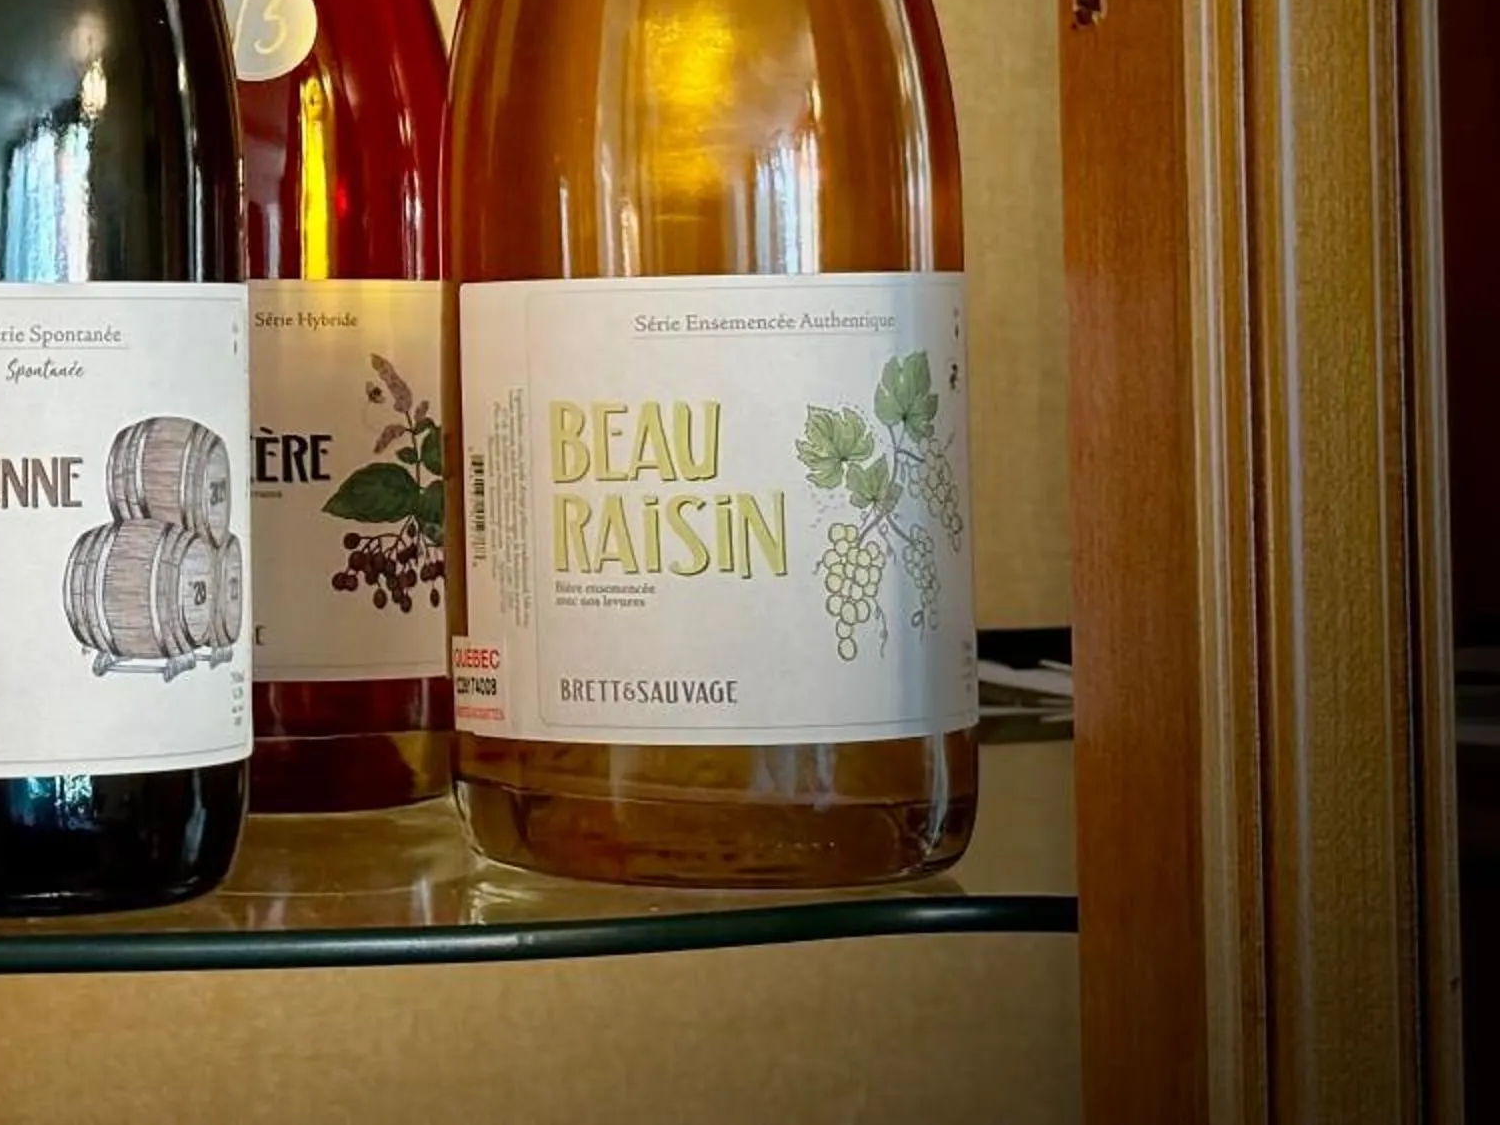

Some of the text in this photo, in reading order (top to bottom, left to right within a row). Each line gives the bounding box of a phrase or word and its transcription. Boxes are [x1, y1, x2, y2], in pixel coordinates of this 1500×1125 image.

[255, 312, 358, 331] Série Hybride
[634, 311, 896, 332] Série Ensemencée Authentique
[29, 324, 122, 348] Spontanée
[6, 357, 85, 384] Spontanée
[548, 400, 721, 484] BEAU
[250, 427, 333, 483] ÈRE
